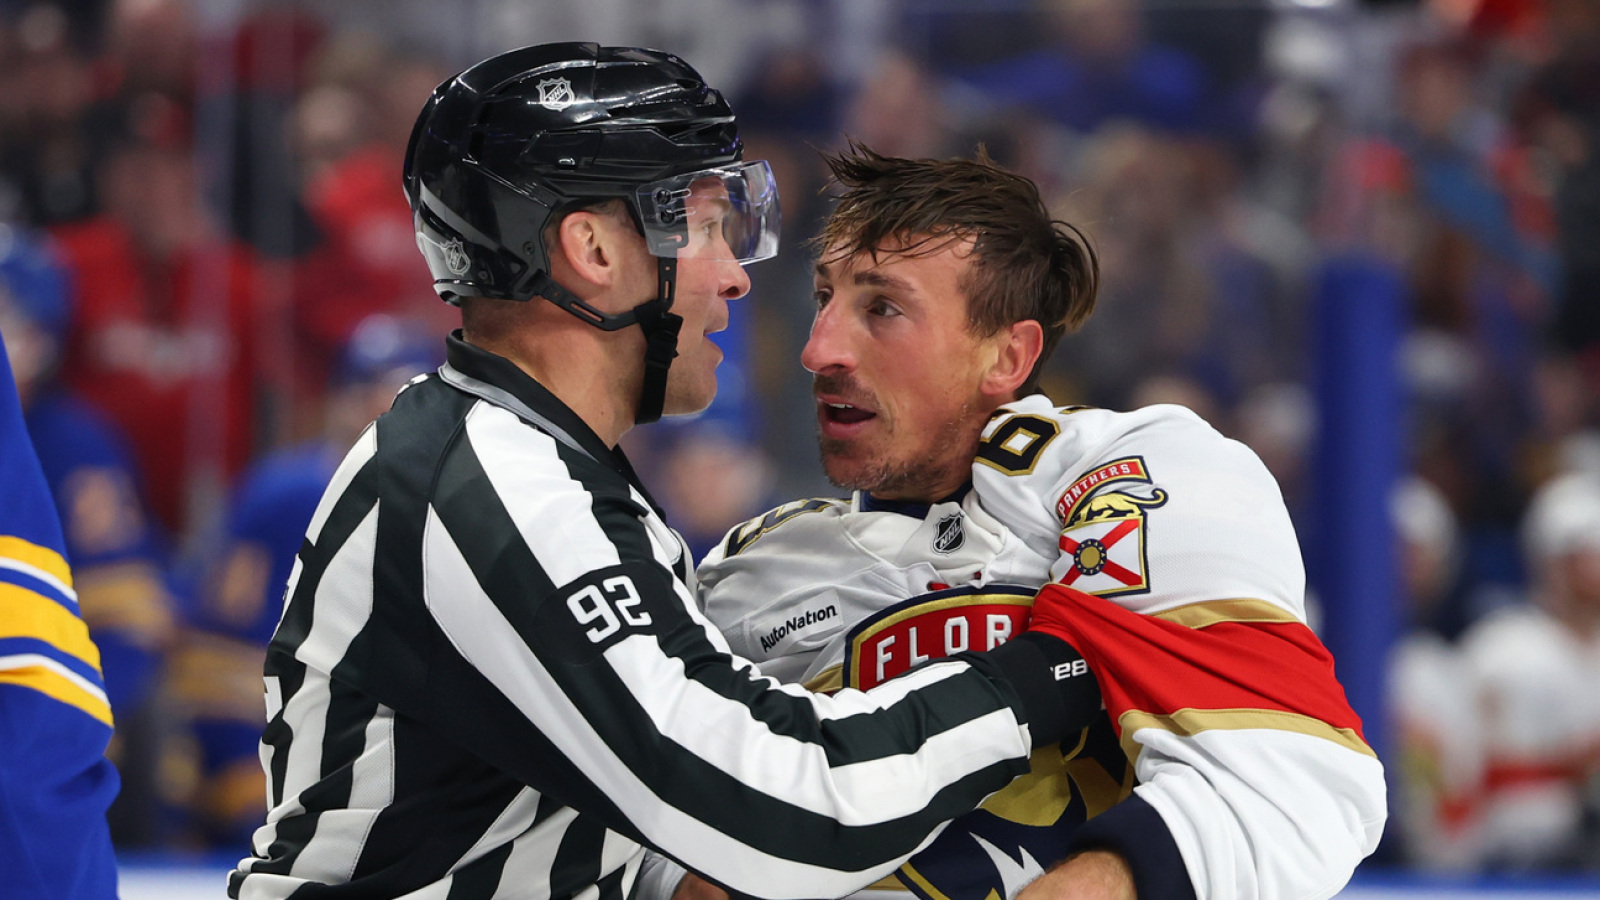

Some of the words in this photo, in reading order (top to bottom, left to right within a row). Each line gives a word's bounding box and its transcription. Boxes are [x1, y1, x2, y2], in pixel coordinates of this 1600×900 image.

[1058, 463, 1131, 518] PANTHERS
[939, 521, 961, 549] NHL
[566, 575, 653, 643] 92
[760, 604, 838, 653] AutoNation
[876, 613, 1032, 682] FLOR
